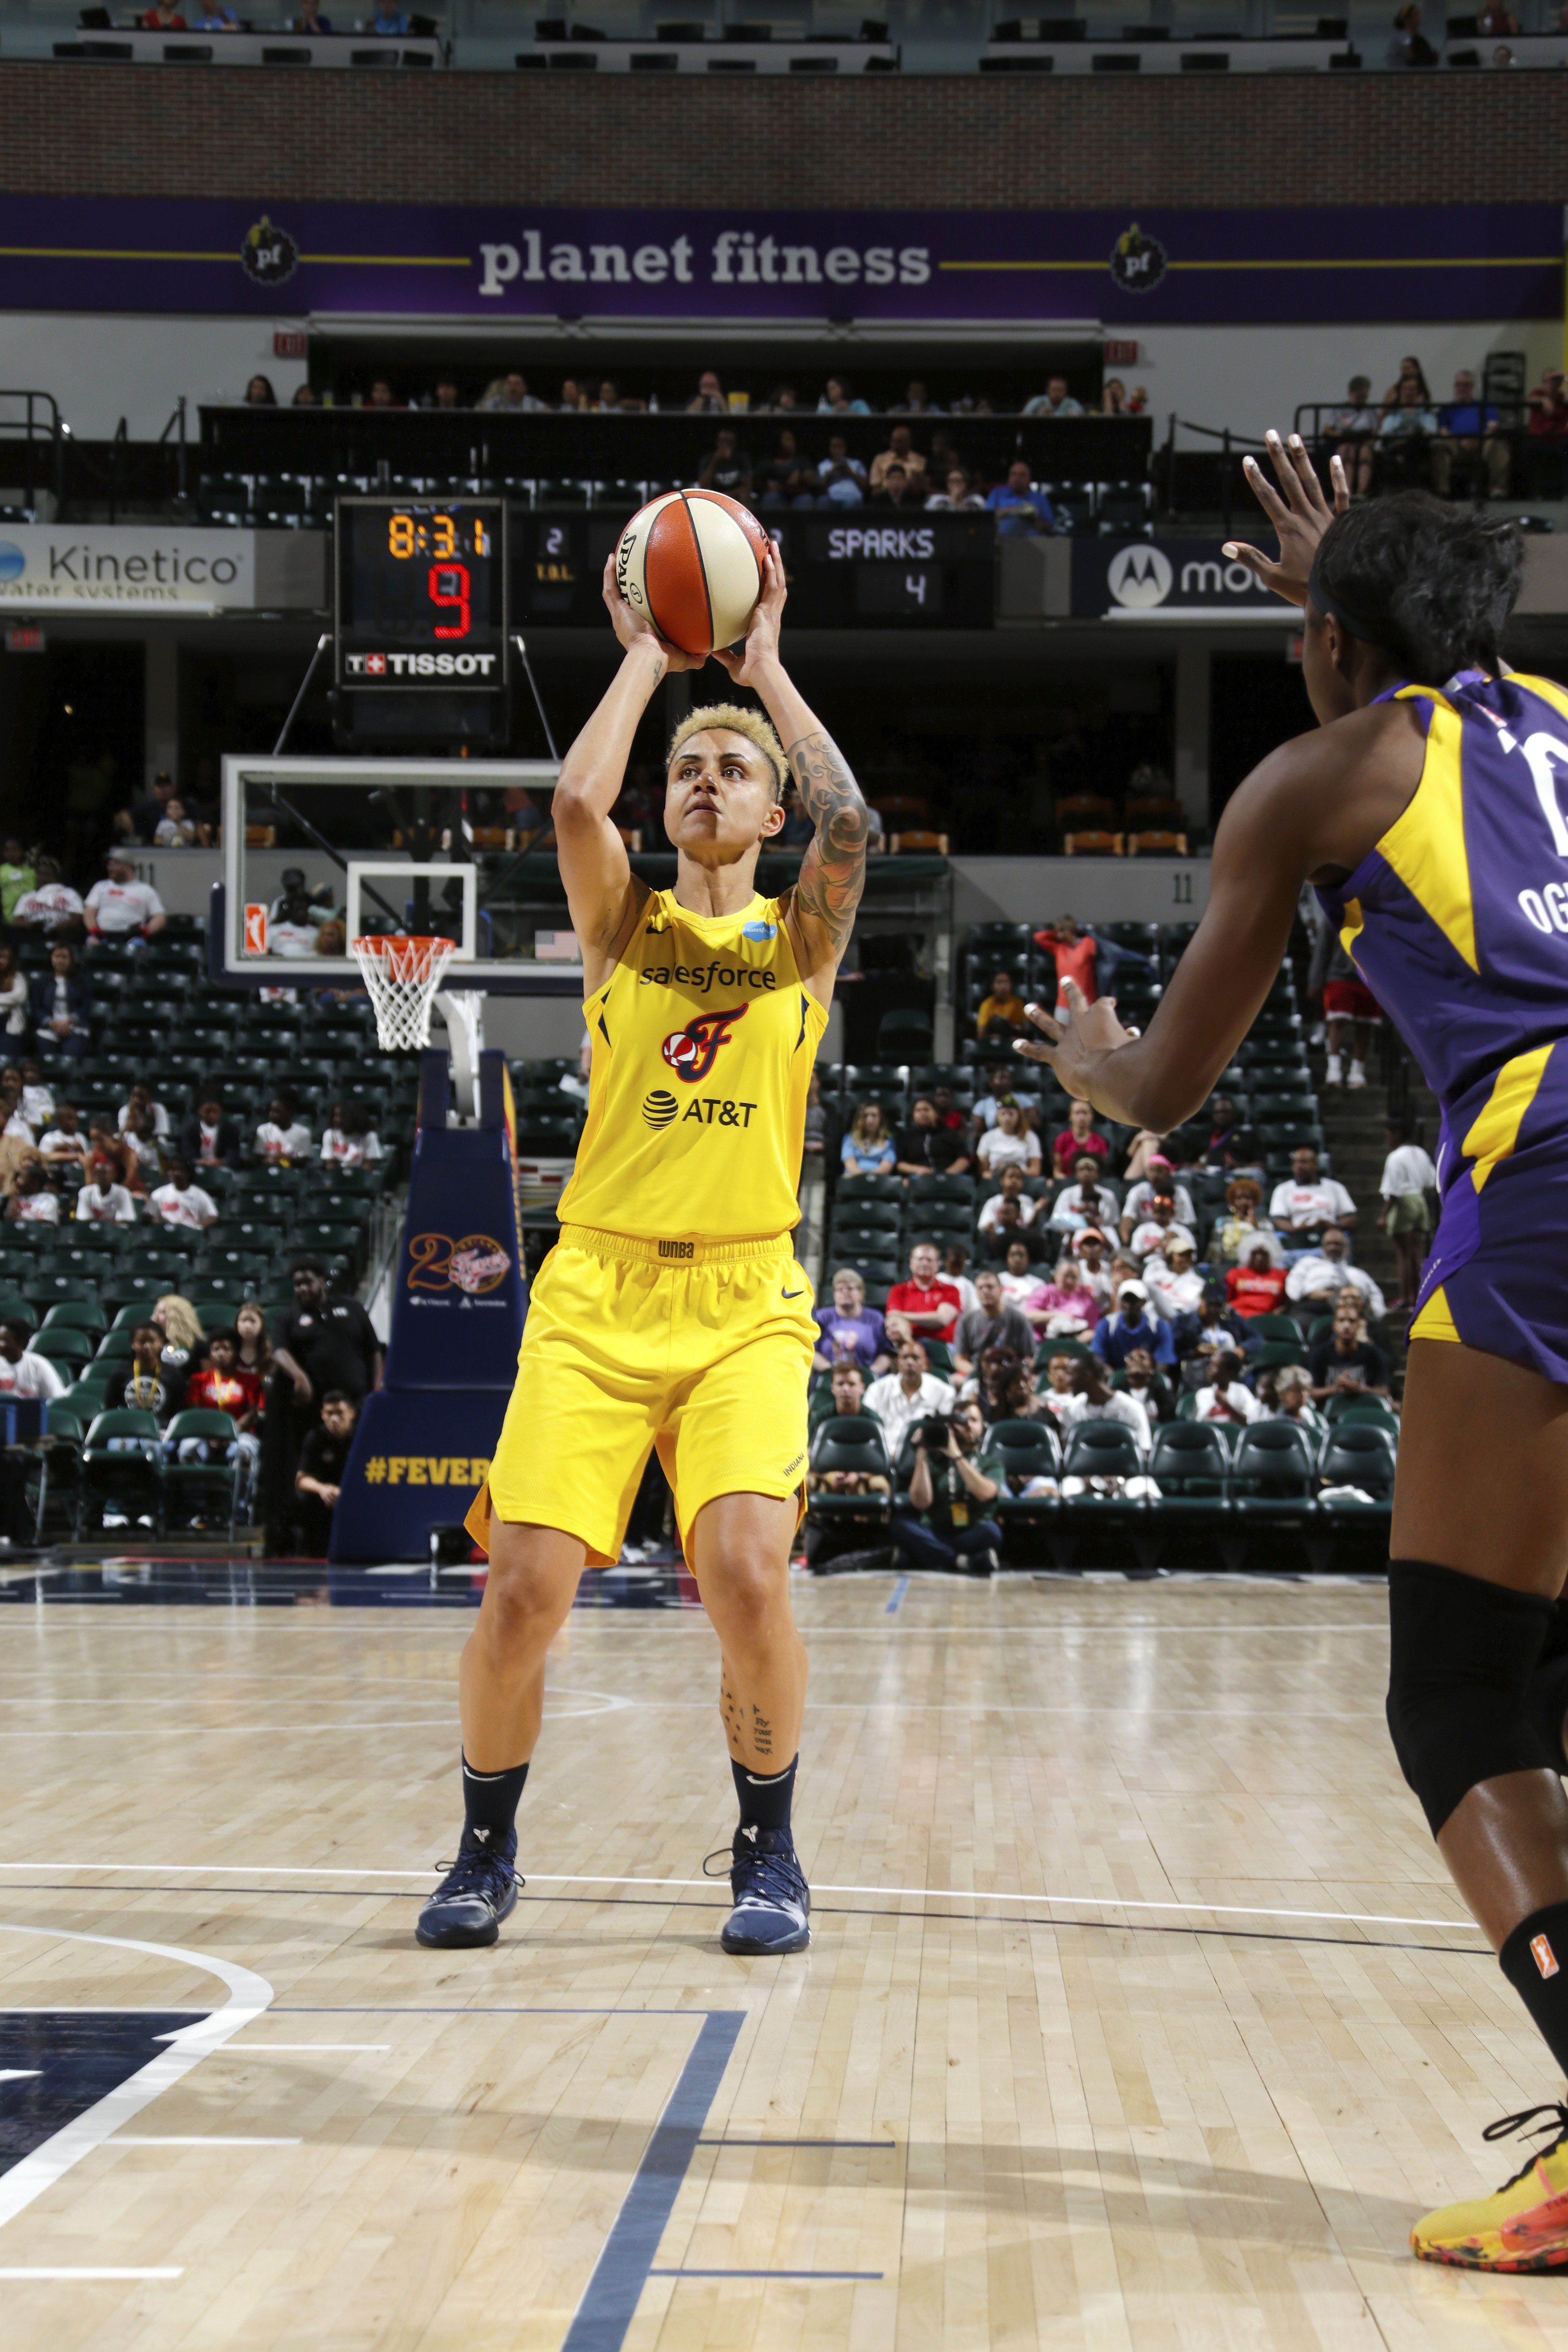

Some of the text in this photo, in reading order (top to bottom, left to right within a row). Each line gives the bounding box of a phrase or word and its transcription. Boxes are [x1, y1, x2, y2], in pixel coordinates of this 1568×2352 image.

[257, 244, 281, 269] pf
[479, 230, 932, 295] planet fitness
[1125, 251, 1151, 277] pf
[389, 514, 483, 559] 8:31
[547, 527, 563, 555] 2
[828, 528, 934, 559] SPARKS
[49, 545, 237, 585] Kinetico
[618, 533, 637, 607] SPALD
[73, 585, 179, 600] systems
[428, 562, 470, 638] 9
[906, 574, 926, 604] 4
[387, 652, 496, 676] TISSOT
[1173, 874, 1193, 904] 11
[1518, 881, 1568, 934] OG
[639, 961, 776, 994] salesforce
[682, 1098, 757, 1128] AT&T
[365, 1455, 491, 1485] #FEVER
[783, 1451, 804, 1477] INDIANA
[753, 1727, 772, 1736] your
[756, 1717, 770, 1728] Fly
[754, 1737, 772, 1745] own
